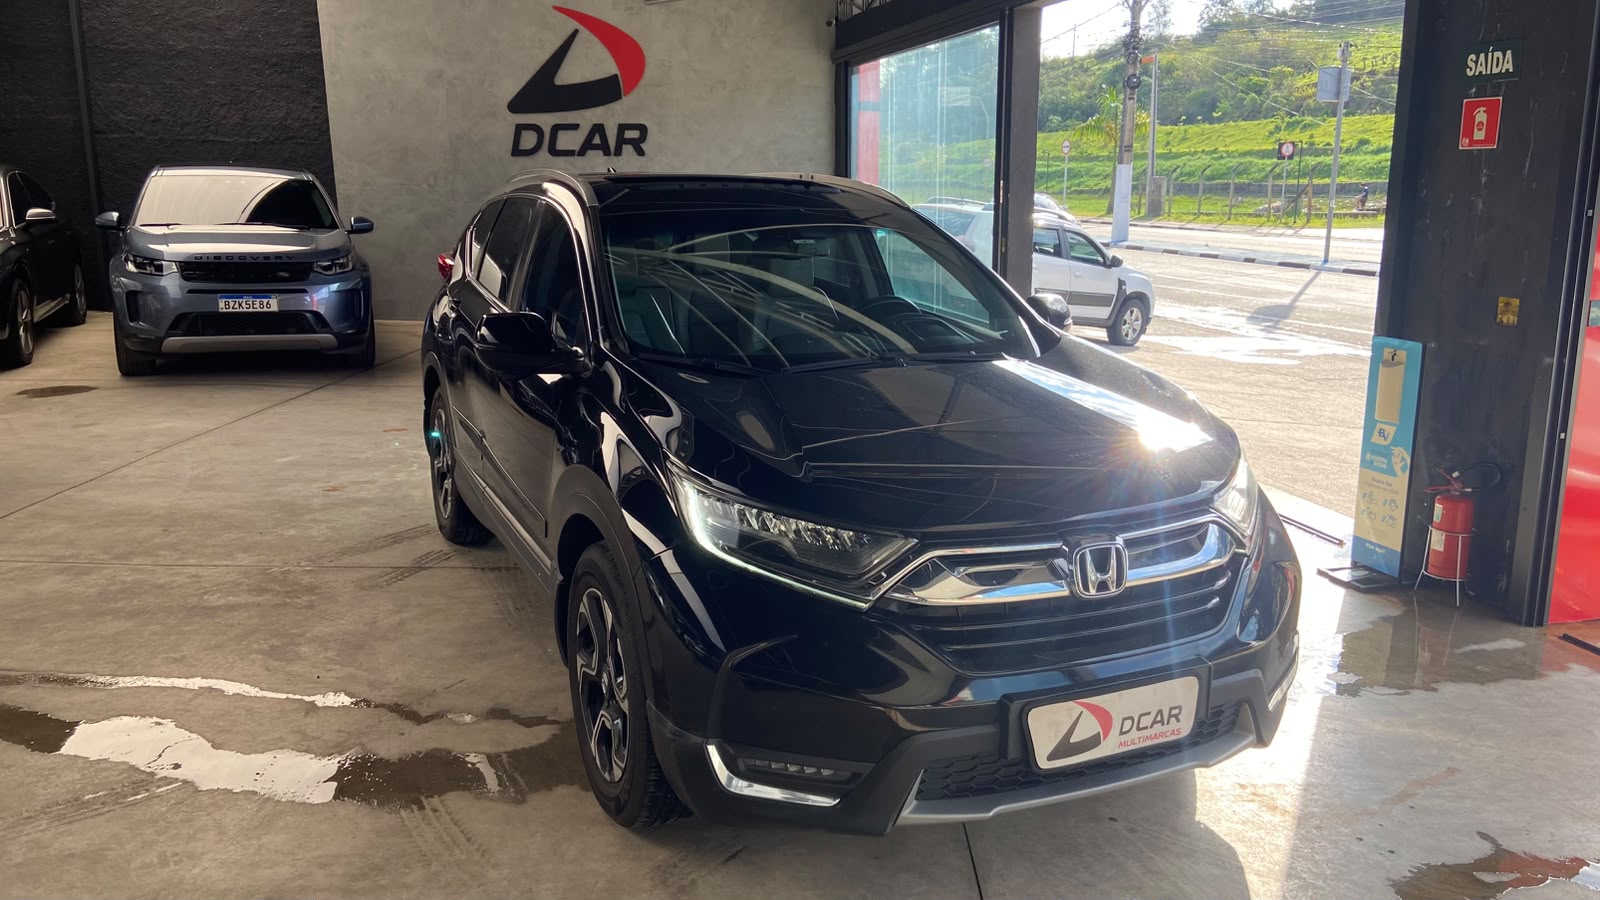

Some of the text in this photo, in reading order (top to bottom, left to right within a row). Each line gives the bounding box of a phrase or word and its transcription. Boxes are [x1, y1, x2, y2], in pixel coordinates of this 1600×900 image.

[1466, 46, 1513, 77] SAÍDA
[511, 123, 648, 157] DCAR
[223, 300, 272, 310] BZK5E86
[1118, 705, 1183, 737] DCAR
[1118, 727, 1182, 749] MULTIMARCAS
